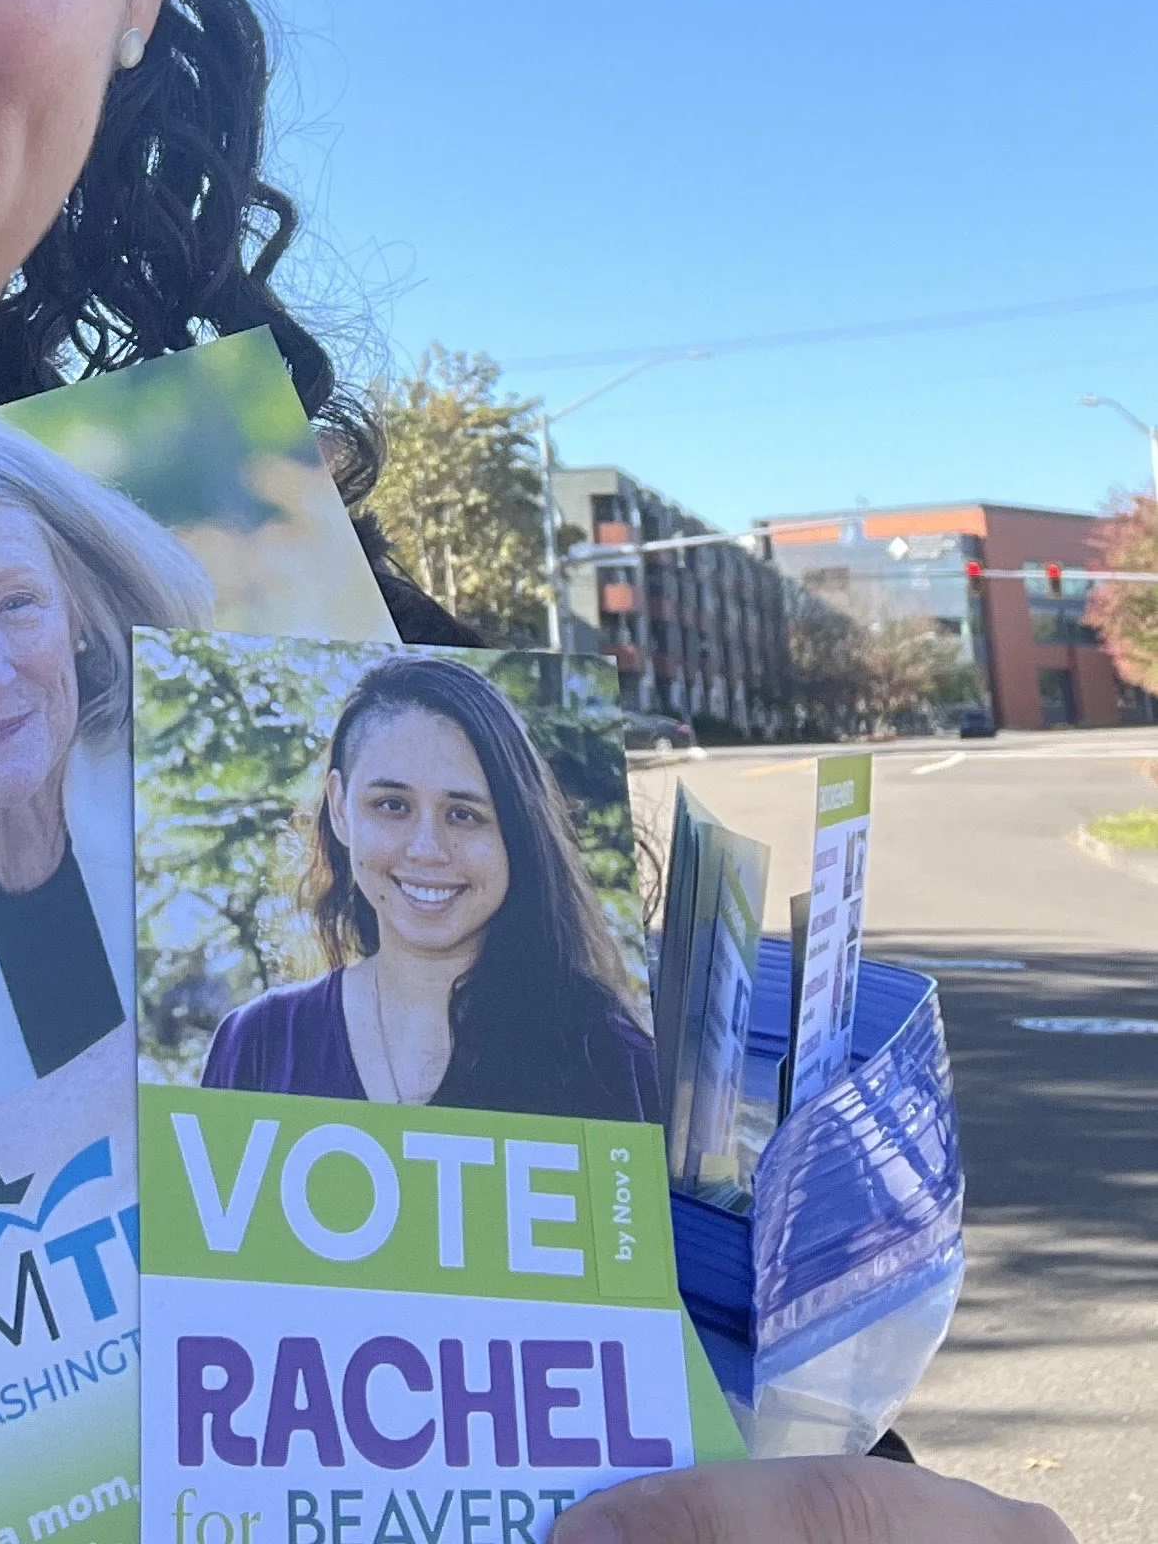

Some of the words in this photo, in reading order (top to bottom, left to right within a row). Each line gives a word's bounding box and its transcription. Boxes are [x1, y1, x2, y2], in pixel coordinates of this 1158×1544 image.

[610, 1147, 630, 1164] 3
[170, 1112, 585, 1277] VOTE
[611, 1169, 632, 1225] Nov
[614, 1230, 637, 1261] by
[176, 1334, 674, 1470] RACHEL
[171, 1487, 262, 1544] for
[287, 1488, 587, 1544] BEAVERT
